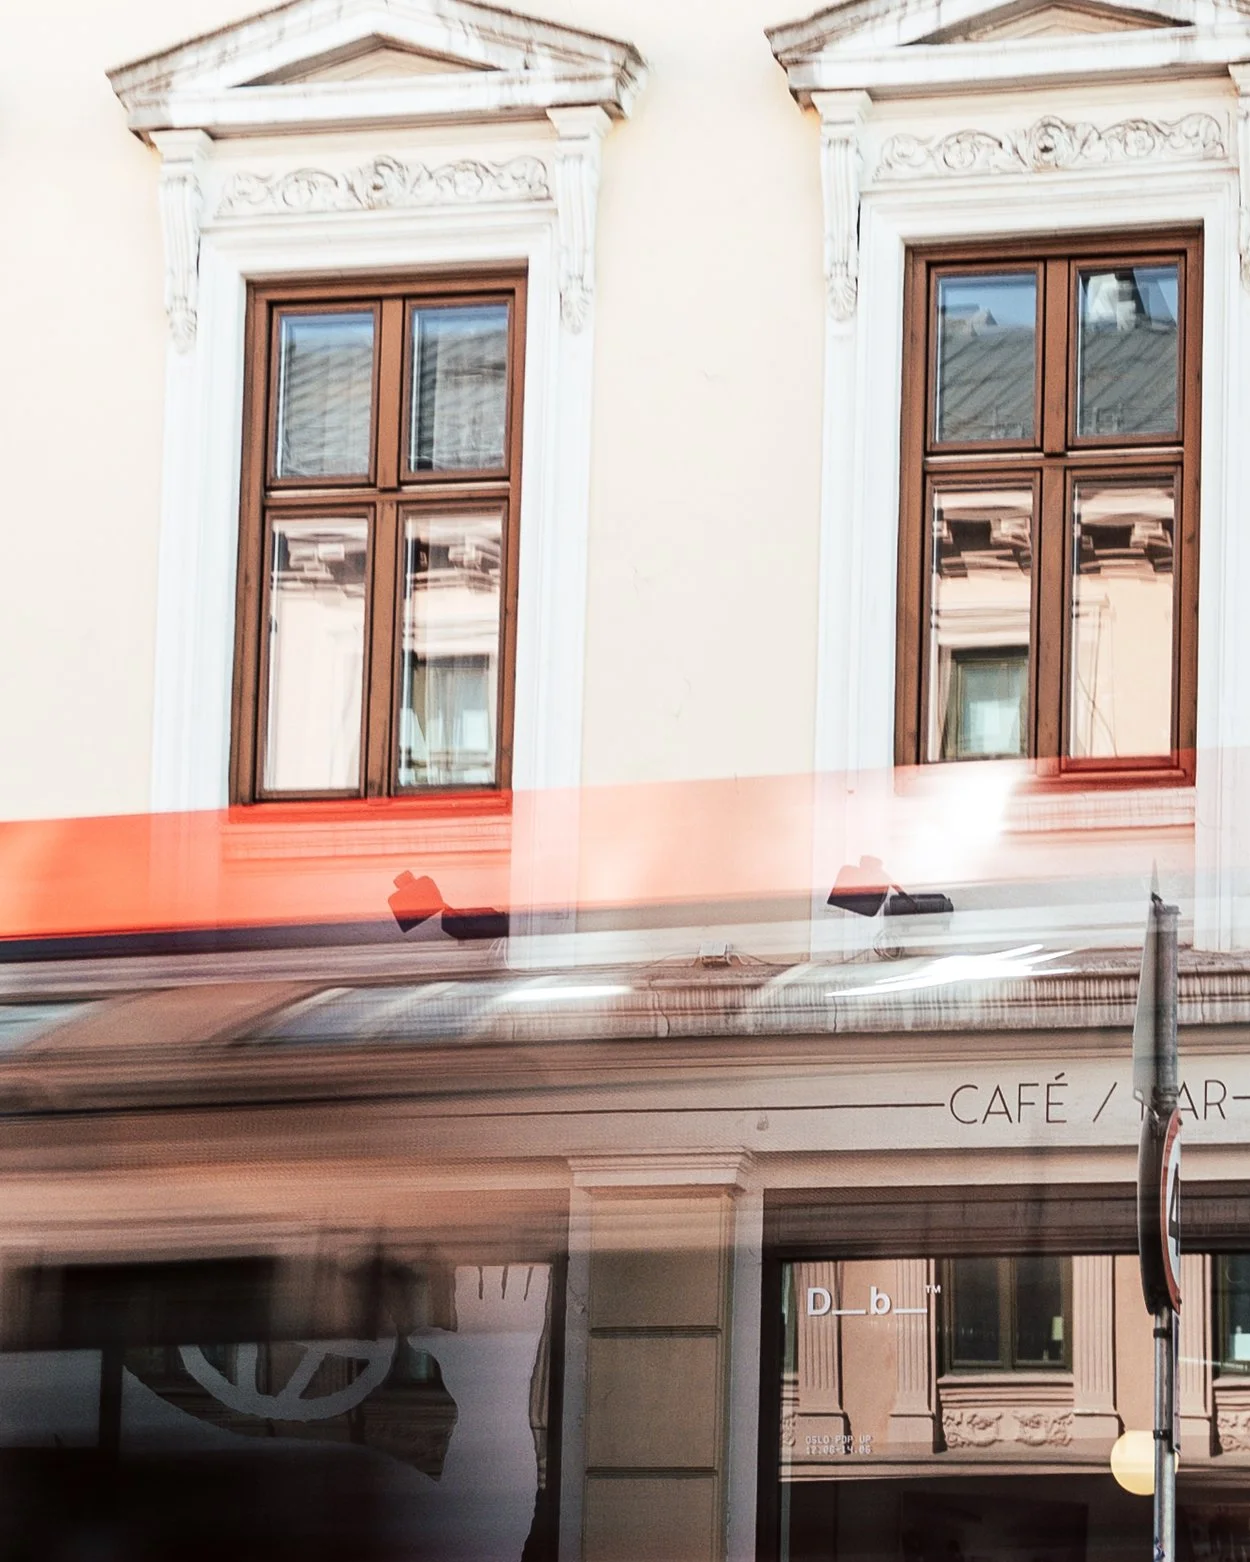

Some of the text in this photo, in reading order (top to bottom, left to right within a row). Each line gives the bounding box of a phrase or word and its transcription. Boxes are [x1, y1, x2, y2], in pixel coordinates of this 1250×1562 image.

[949, 1072, 1069, 1125] CAFÉ
[1139, 1079, 1228, 1122] AR
[806, 1434, 872, 1445] OSLO POP UP
